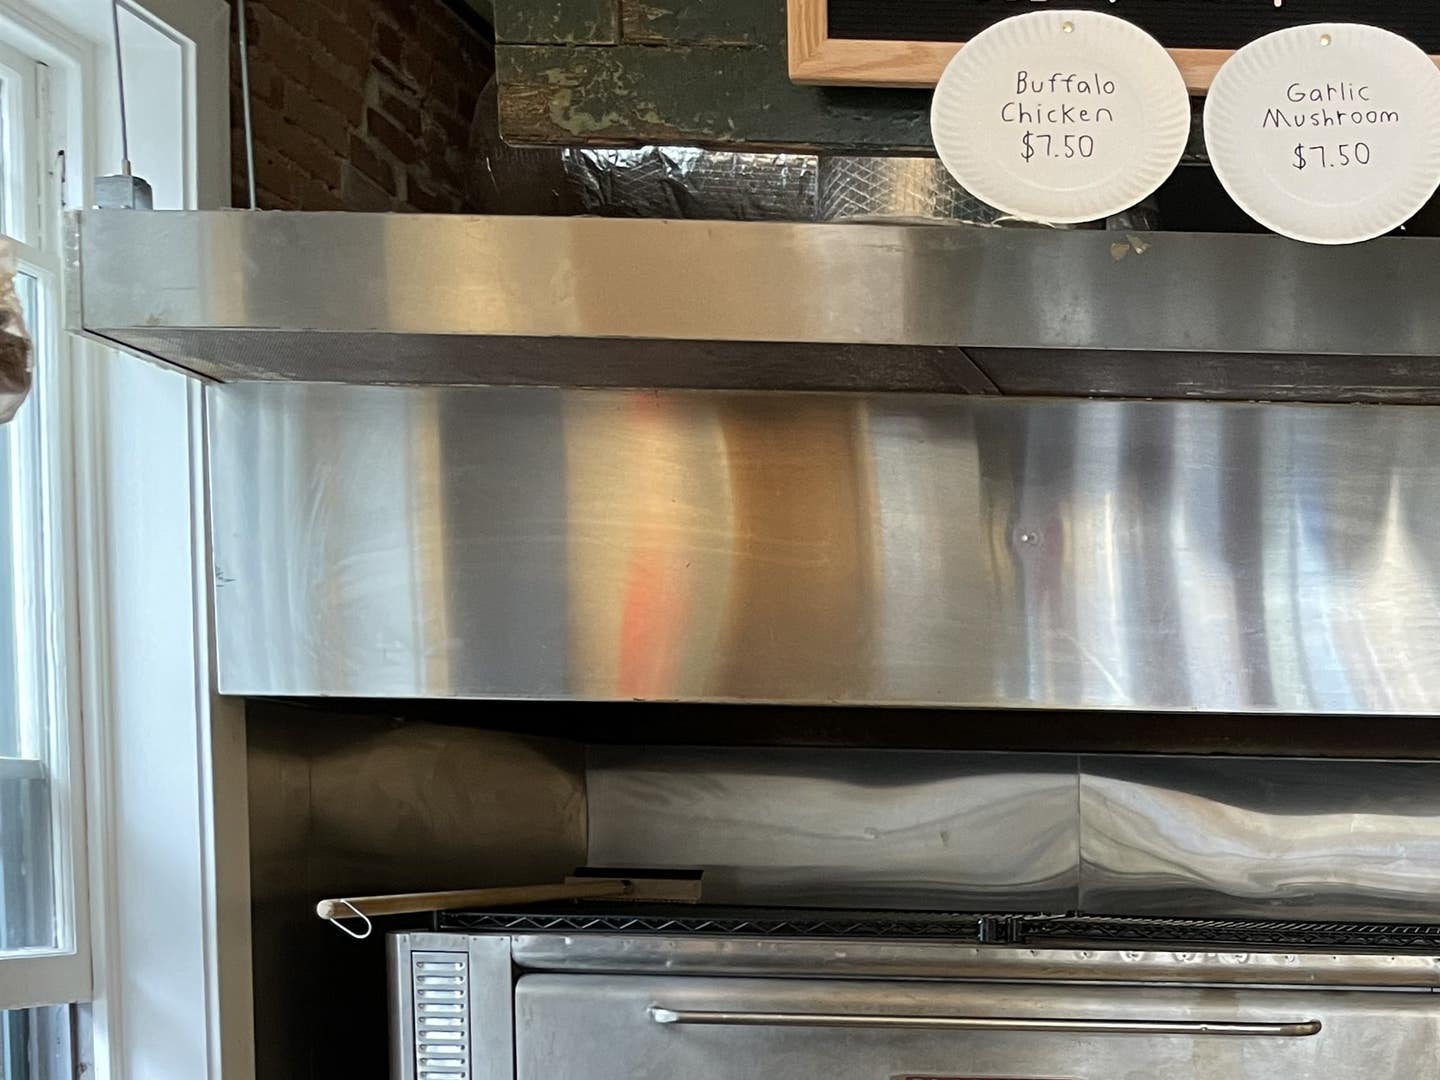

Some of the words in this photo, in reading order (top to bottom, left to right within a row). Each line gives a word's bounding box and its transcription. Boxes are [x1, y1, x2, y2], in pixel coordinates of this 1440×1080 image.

[1016, 70, 1116, 94] Buffalo
[1287, 82, 1370, 103] Garlic
[1001, 102, 1113, 124] Chicken
[1262, 108, 1399, 128] Mushroom
[1021, 130, 1094, 163] $7.50
[1292, 142, 1370, 170] $7.50
